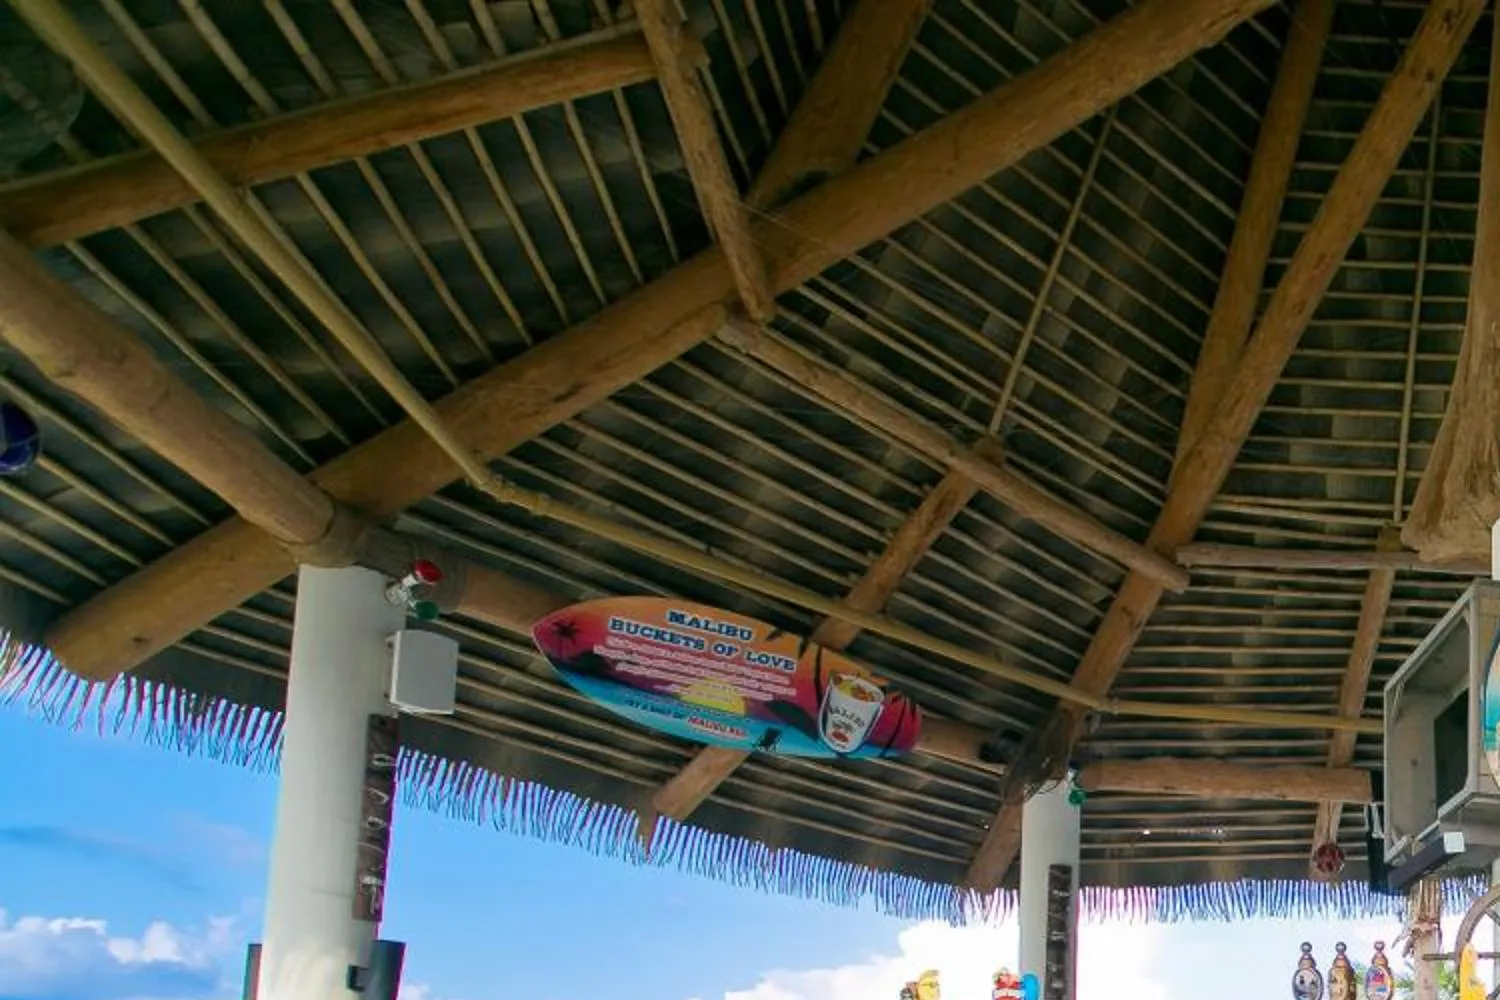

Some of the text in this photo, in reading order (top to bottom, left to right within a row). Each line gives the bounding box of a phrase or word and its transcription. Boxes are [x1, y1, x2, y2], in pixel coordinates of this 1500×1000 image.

[610, 617, 705, 650] BUCKETS
[713, 642, 738, 657] OF
[745, 651, 796, 672] LOVE
[668, 610, 753, 641] MALIBU
